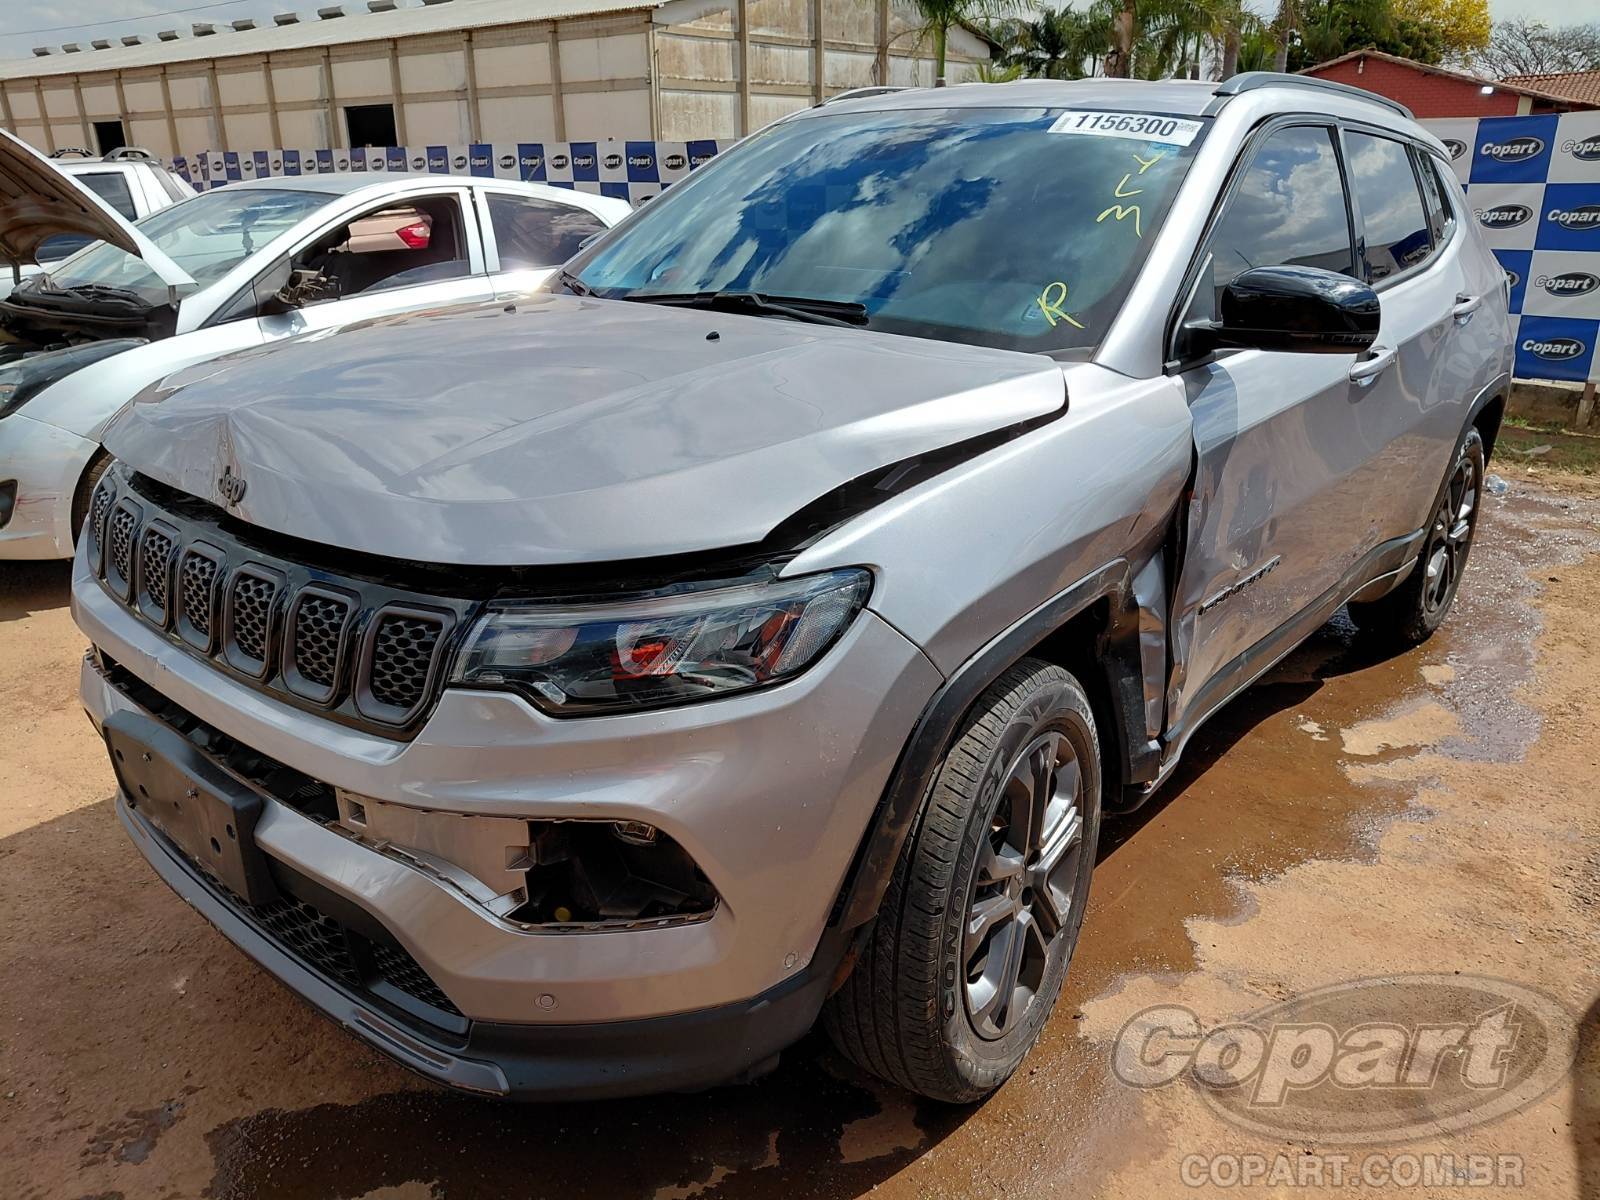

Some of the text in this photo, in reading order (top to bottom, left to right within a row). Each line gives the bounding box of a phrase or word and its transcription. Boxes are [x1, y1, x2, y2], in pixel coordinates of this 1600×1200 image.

[1075, 114, 1177, 137] 1156300
[1481, 142, 1537, 157] Copart
[1561, 139, 1600, 155] Copa
[573, 156, 592, 167] Copart
[628, 156, 651, 166] Copart
[664, 156, 683, 167] opart
[1535, 275, 1591, 290] Copart
[1037, 282, 1086, 329] R
[1522, 339, 1577, 355] Copart
